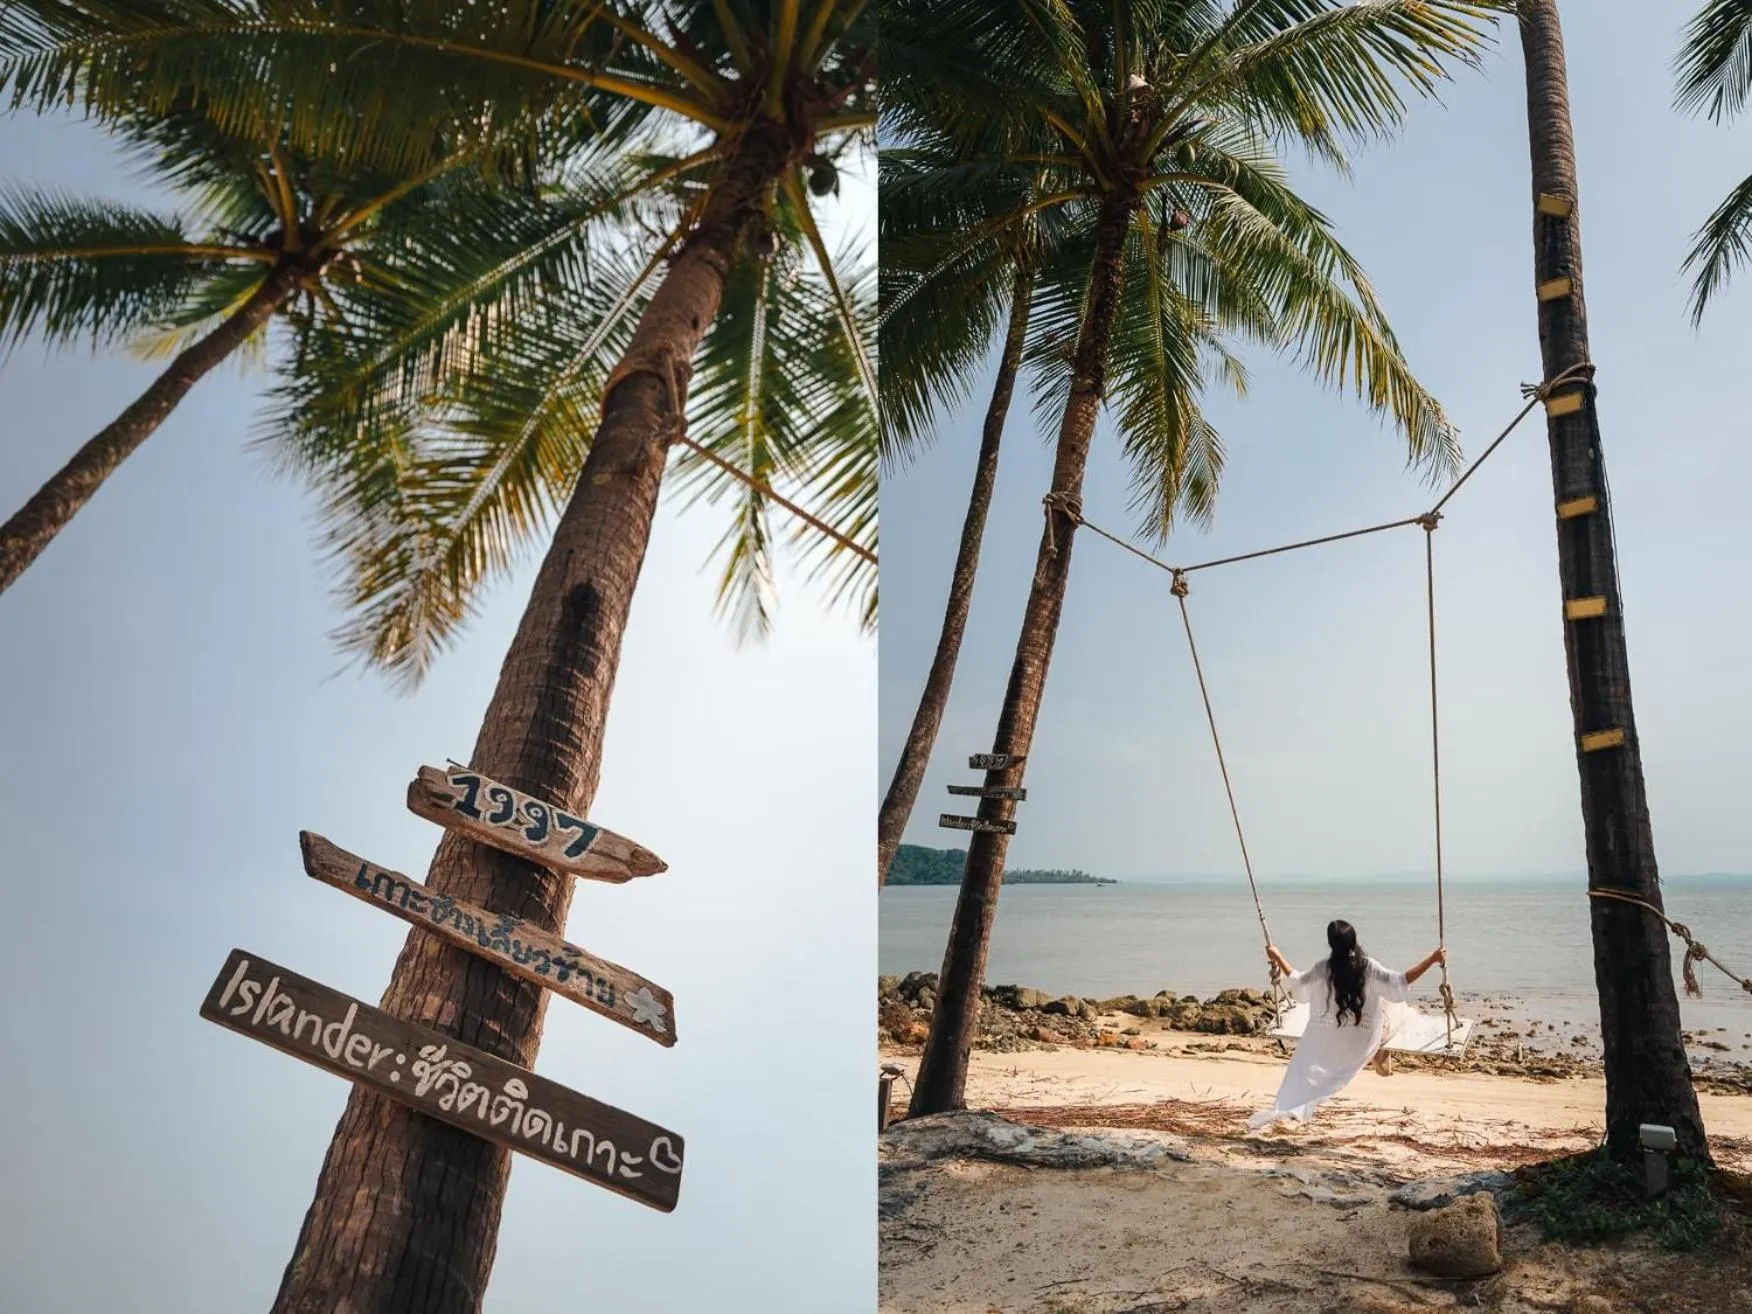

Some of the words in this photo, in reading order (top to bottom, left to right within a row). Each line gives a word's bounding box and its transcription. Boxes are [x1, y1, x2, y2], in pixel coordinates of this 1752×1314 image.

[450, 772, 600, 860] 1997
[219, 960, 405, 1083] Islander:
[411, 1043, 644, 1179] ชีวิตติดเกาะ
